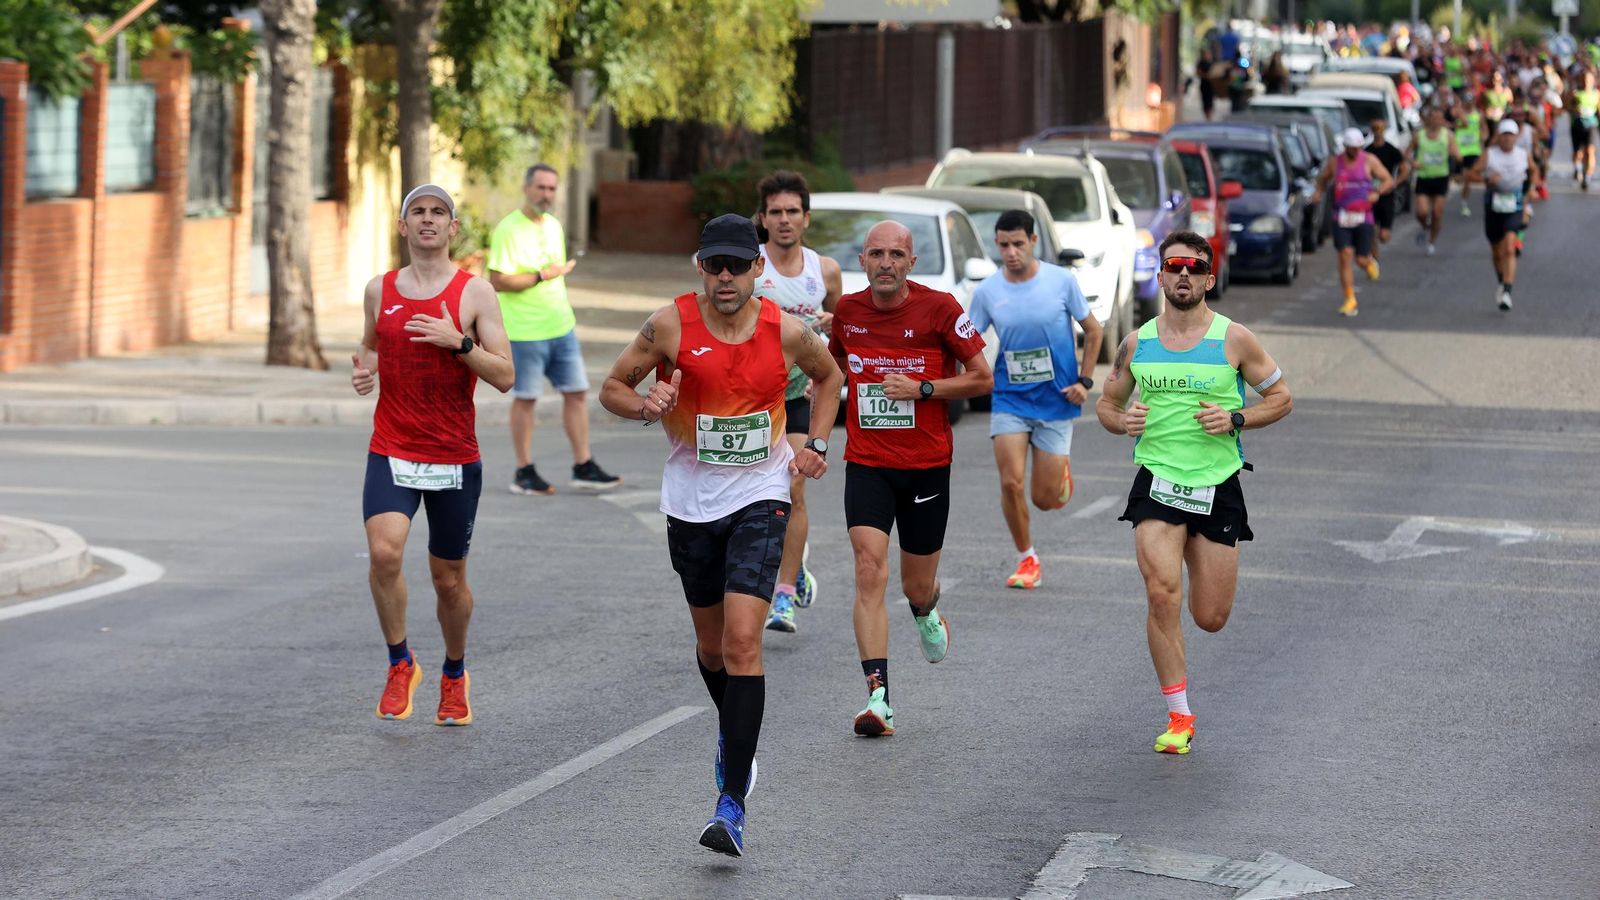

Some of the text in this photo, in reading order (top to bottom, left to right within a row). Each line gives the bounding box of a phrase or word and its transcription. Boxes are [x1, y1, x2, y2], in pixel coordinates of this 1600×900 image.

[863, 356, 925, 367] muebles miguel
[1021, 361, 1036, 372] 54
[1141, 374, 1211, 390] NutreTec
[869, 399, 899, 414] 104
[722, 433, 748, 450] 87
